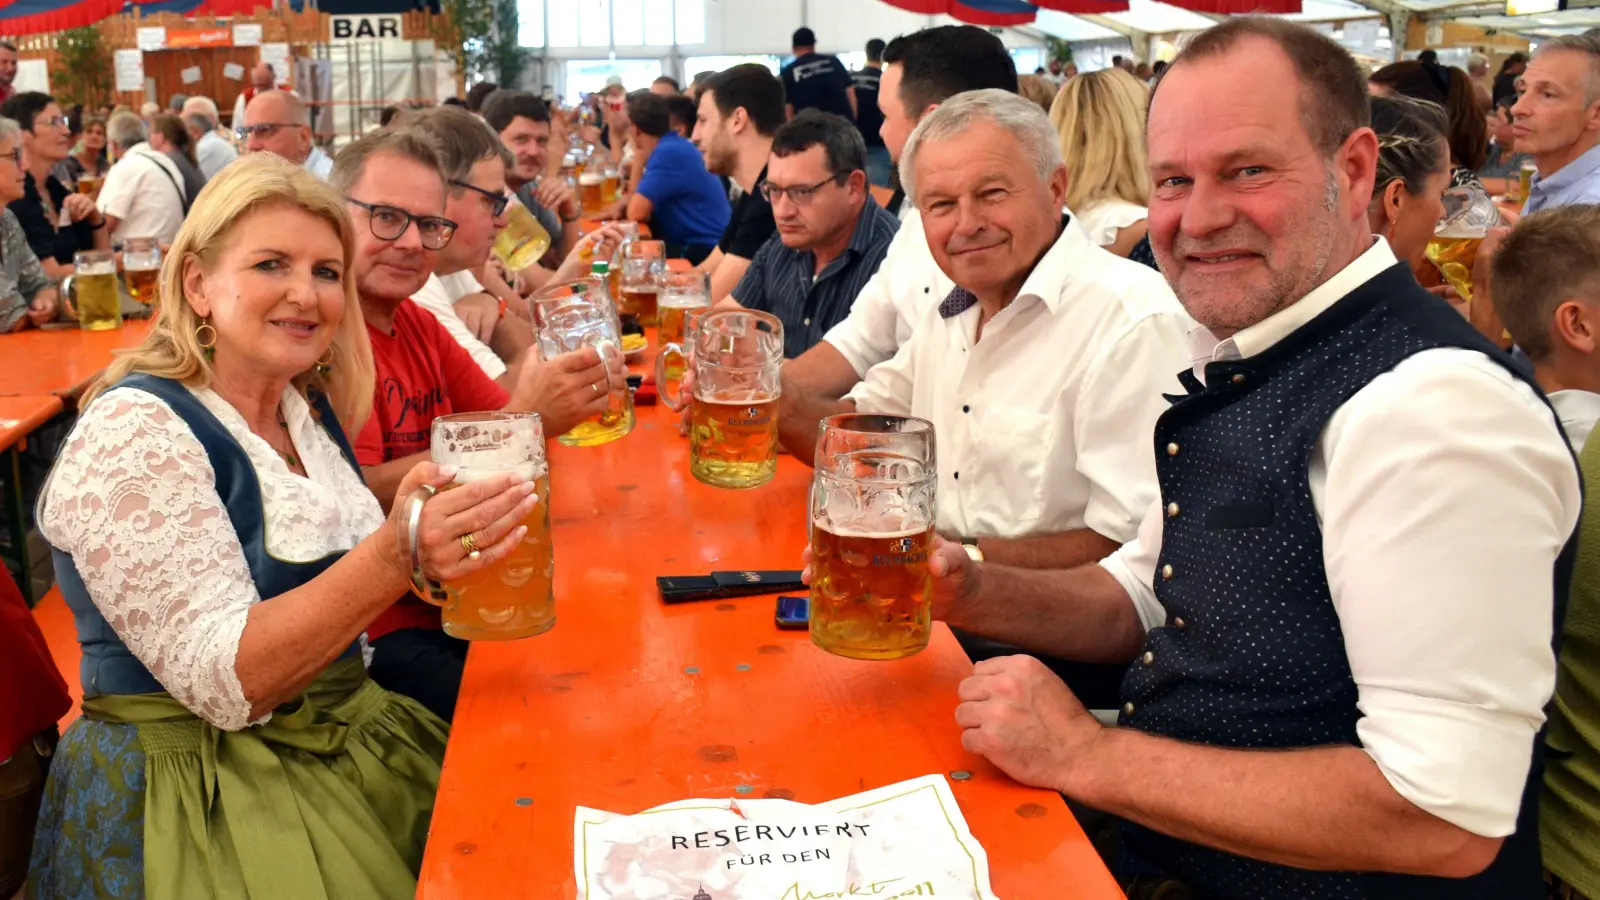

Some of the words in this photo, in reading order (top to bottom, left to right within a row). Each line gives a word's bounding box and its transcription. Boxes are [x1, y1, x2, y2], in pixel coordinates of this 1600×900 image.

[333, 18, 398, 37] BAR
[671, 822, 870, 850] RESERVIERT
[726, 853, 772, 869] FÜR
[782, 848, 831, 863] DEN
